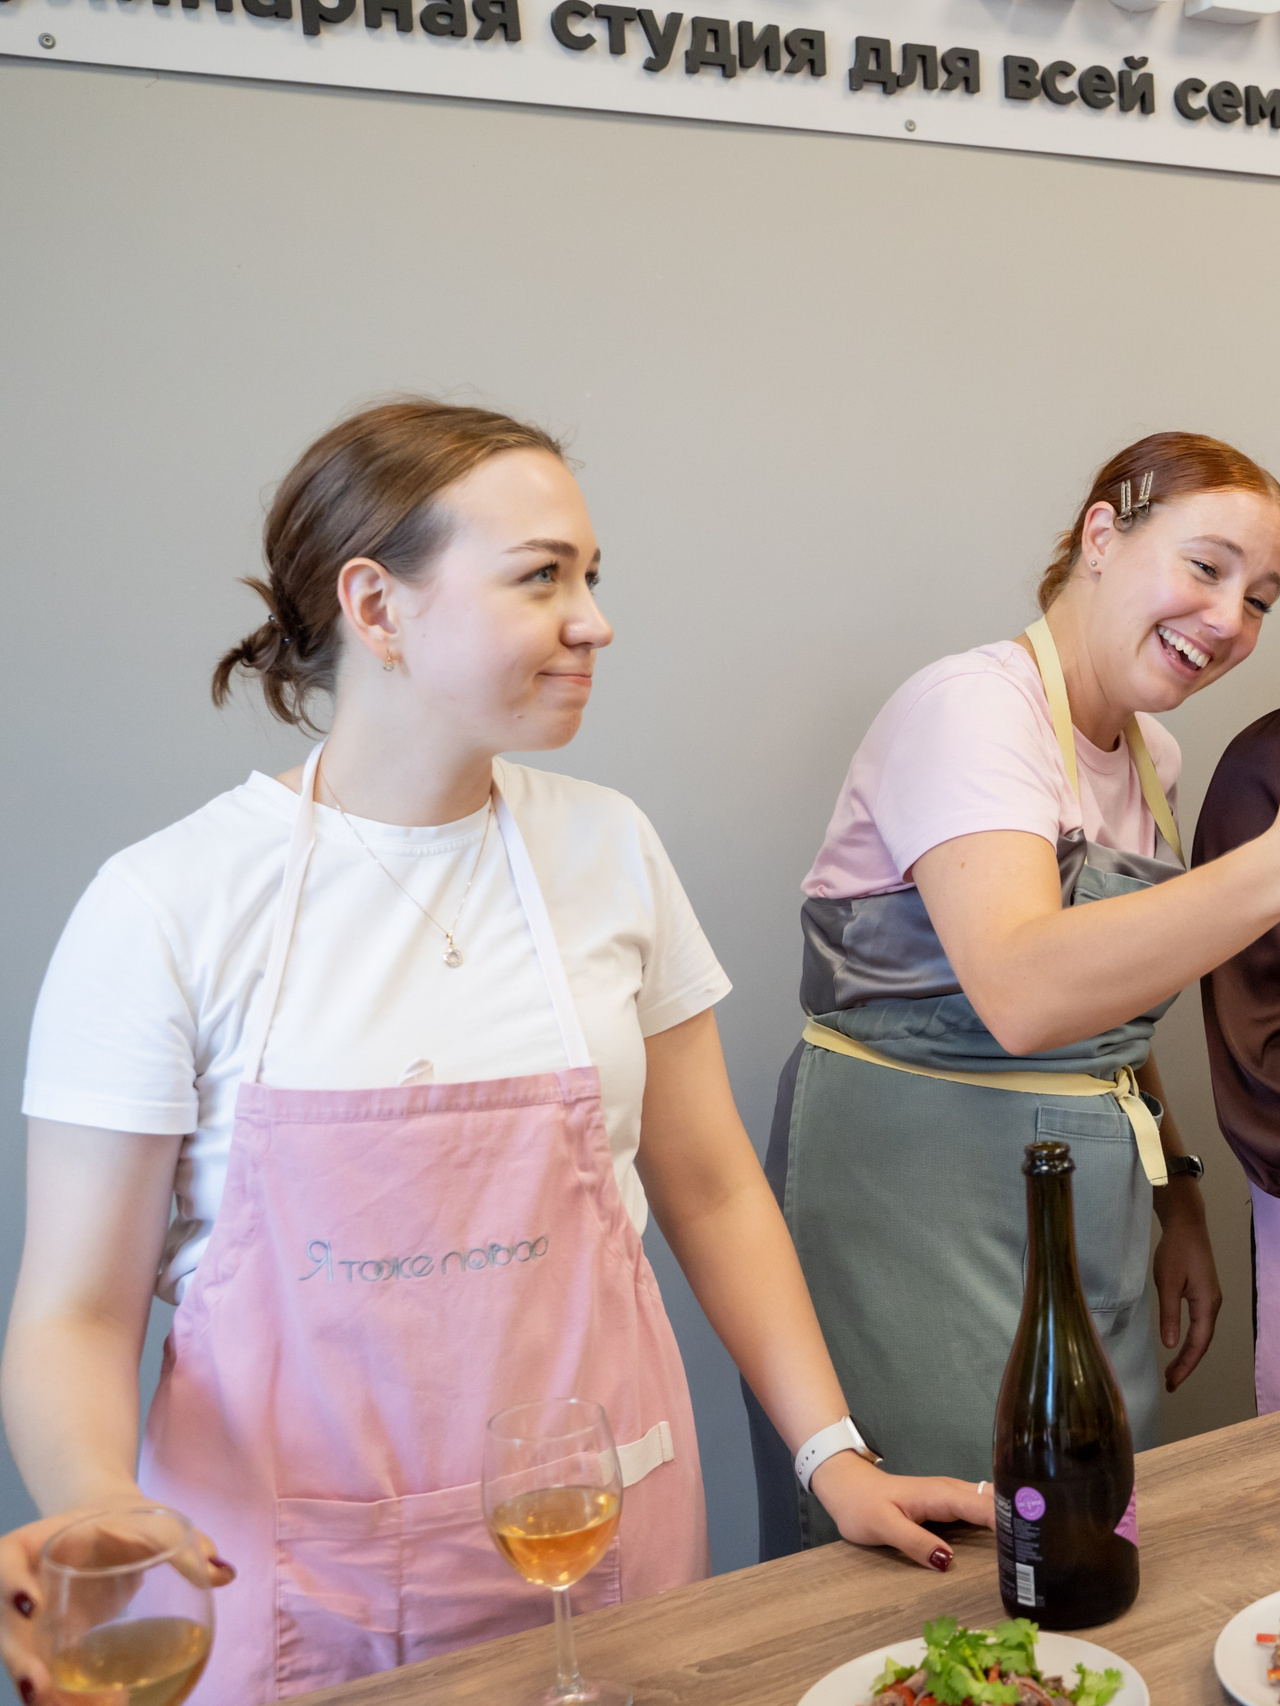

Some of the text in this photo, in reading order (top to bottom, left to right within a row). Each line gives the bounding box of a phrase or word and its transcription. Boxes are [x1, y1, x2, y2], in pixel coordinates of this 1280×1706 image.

[551, 0, 827, 80] студия
[849, 35, 980, 96] для
[1003, 54, 1155, 116] всей
[298, 1234, 548, 1284] Я тоже повар
